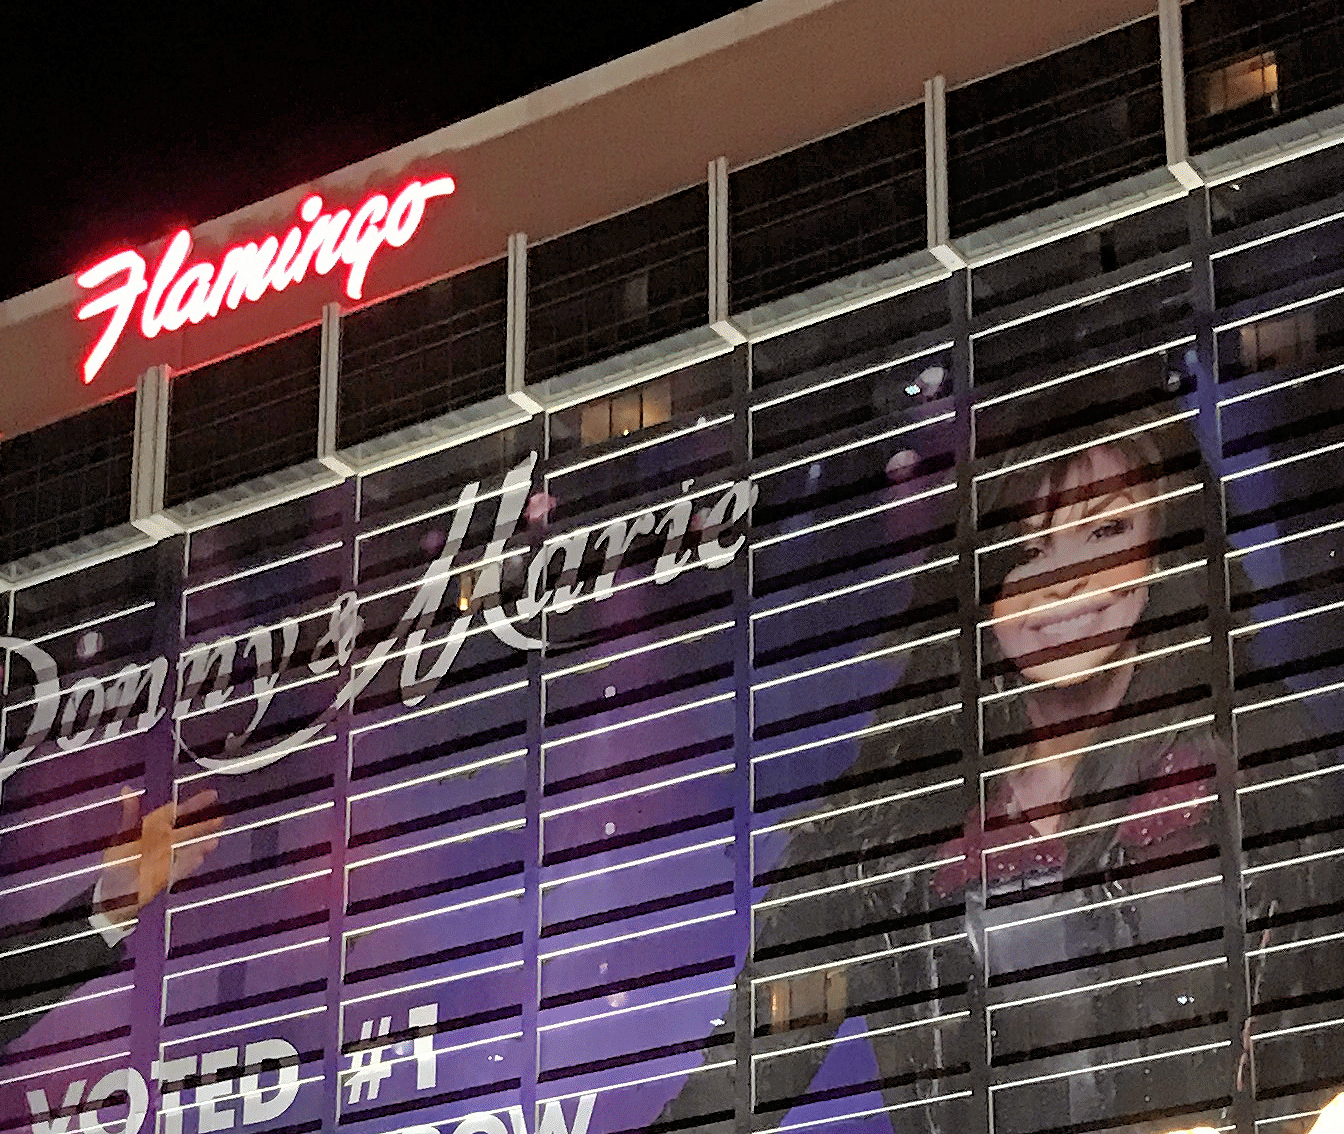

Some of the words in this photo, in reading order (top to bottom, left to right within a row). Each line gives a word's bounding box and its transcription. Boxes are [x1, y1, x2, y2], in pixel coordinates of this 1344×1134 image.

[77, 177, 455, 384] Flamingo
[174, 450, 760, 776] Marie
[306, 589, 365, 674] &
[340, 1003, 440, 1106] #1
